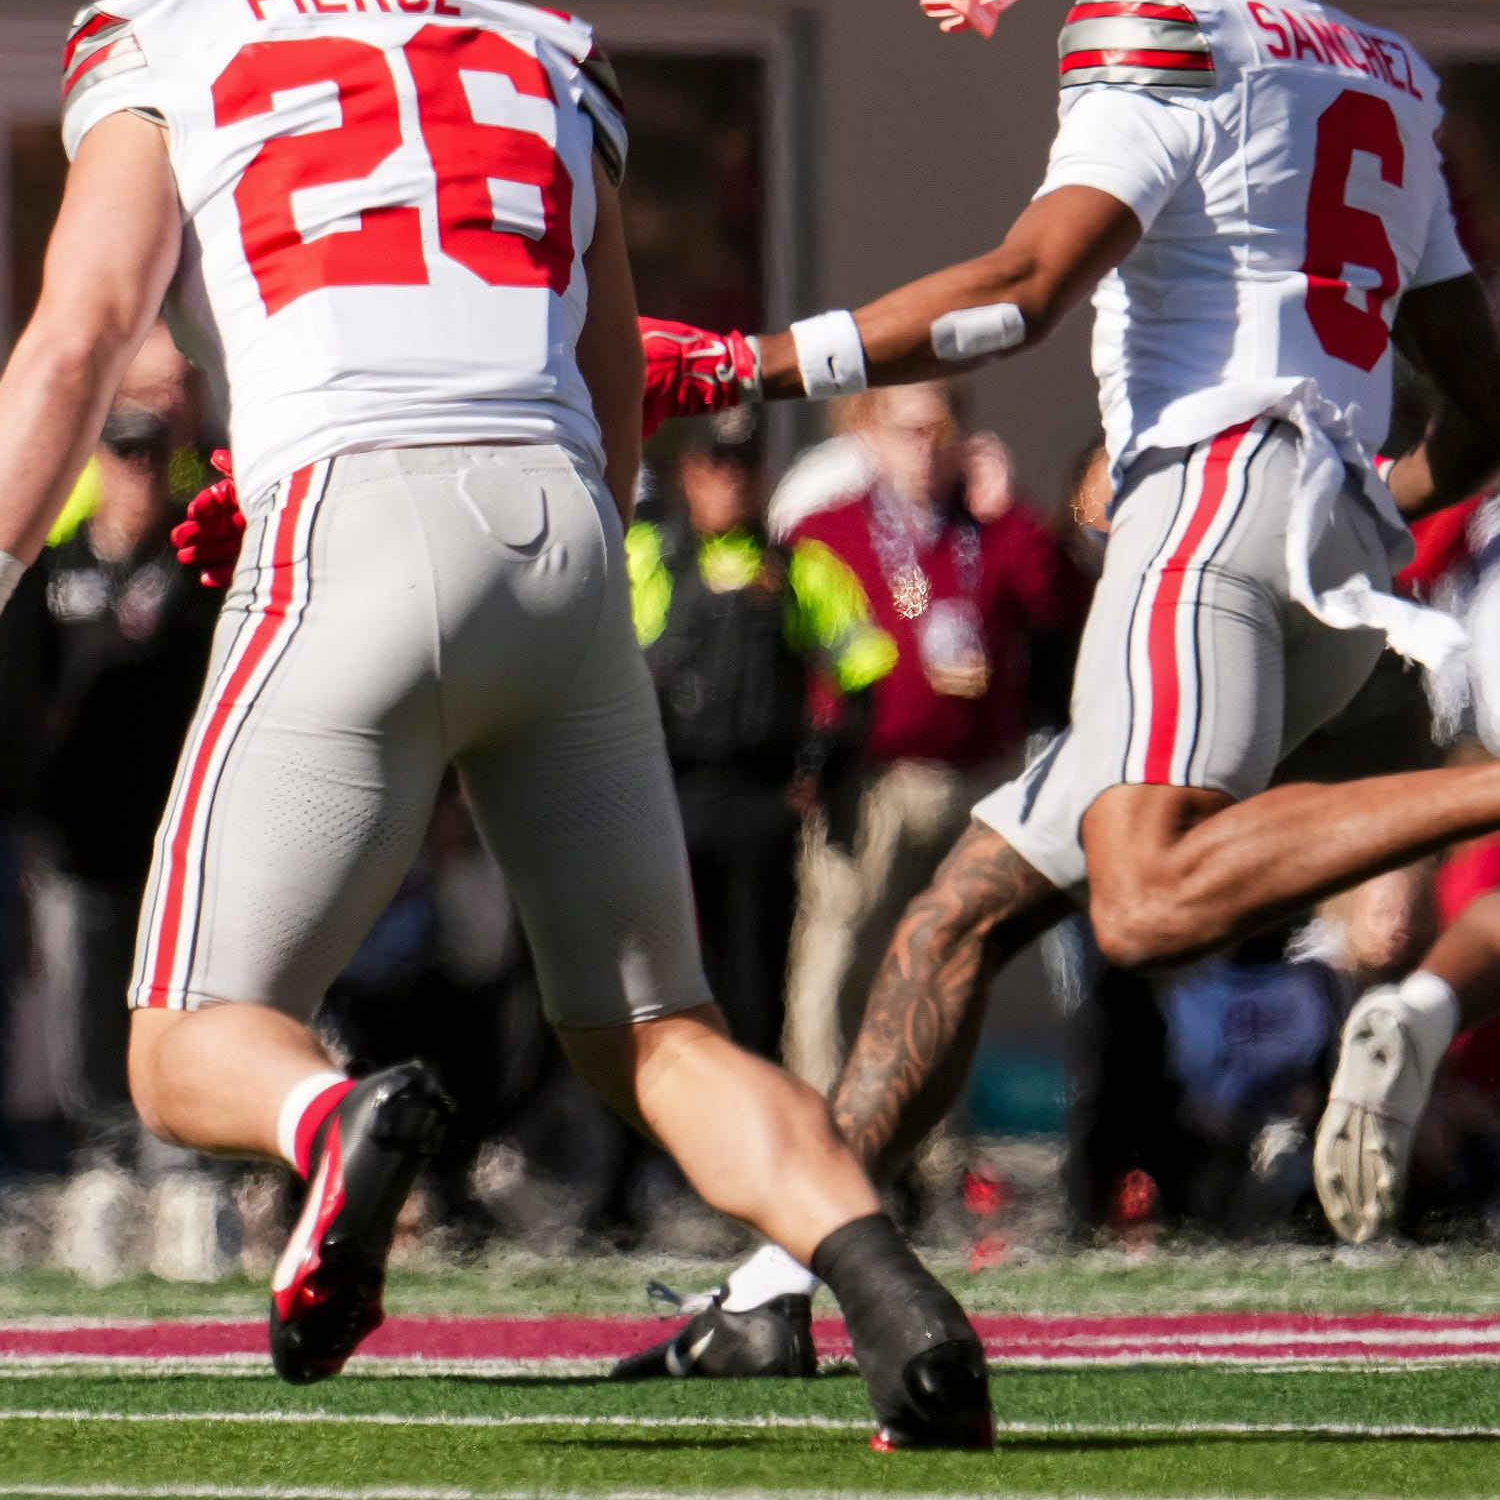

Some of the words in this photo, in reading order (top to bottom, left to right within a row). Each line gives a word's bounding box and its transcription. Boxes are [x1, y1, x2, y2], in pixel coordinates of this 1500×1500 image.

[210, 24, 575, 318] 26
[1246, 0, 1425, 102] SANCHEZ
[1301, 88, 1406, 374] 6
